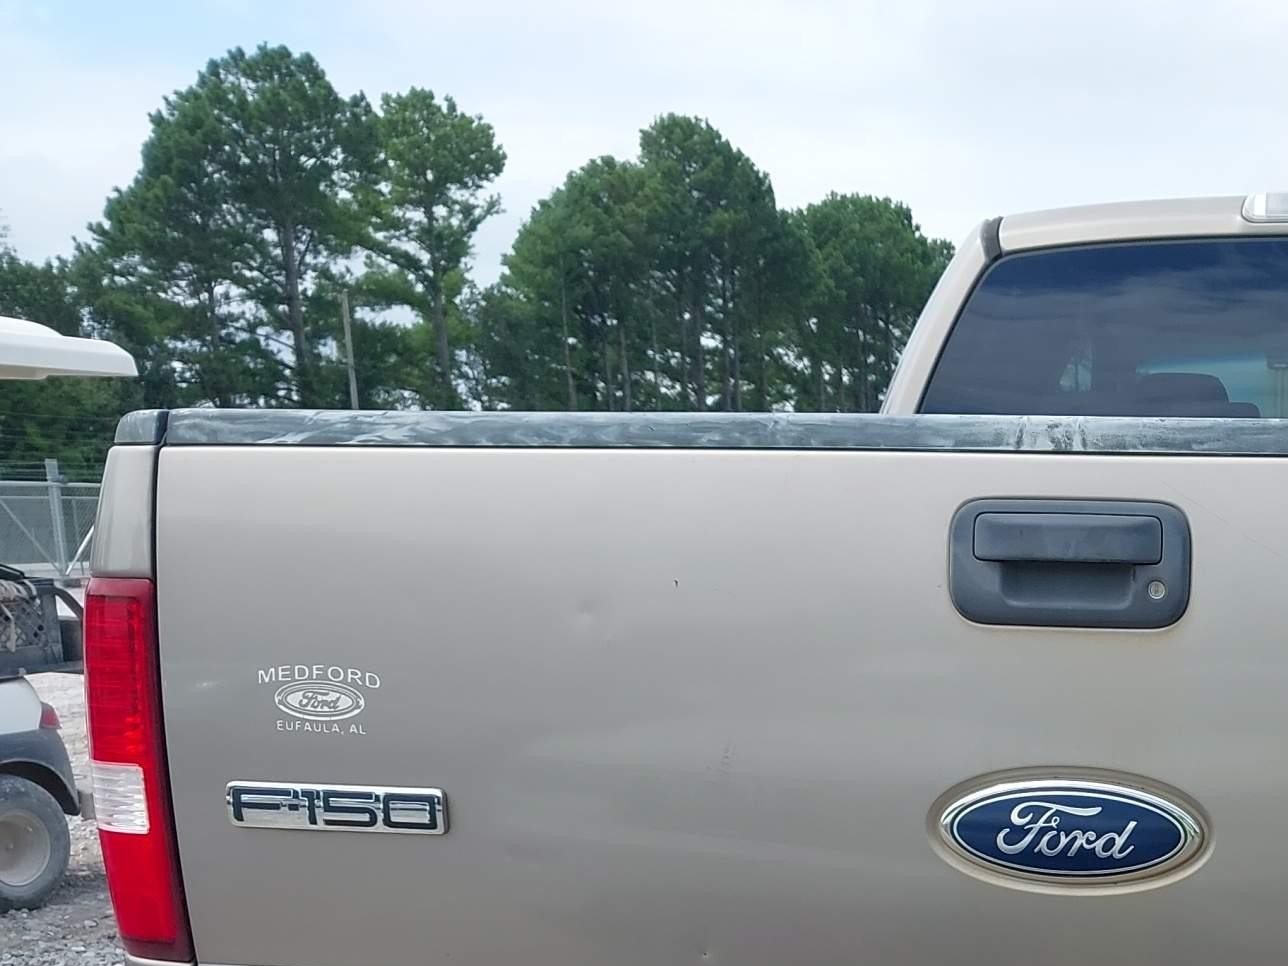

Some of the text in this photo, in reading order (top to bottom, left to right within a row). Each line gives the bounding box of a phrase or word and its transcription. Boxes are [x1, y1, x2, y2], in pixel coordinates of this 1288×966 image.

[258, 665, 381, 689] MEDFORD
[299, 690, 342, 711] Ford
[276, 720, 367, 736] EUFAULA, AL
[231, 786, 438, 831] F-150
[996, 801, 1138, 860] Ford
